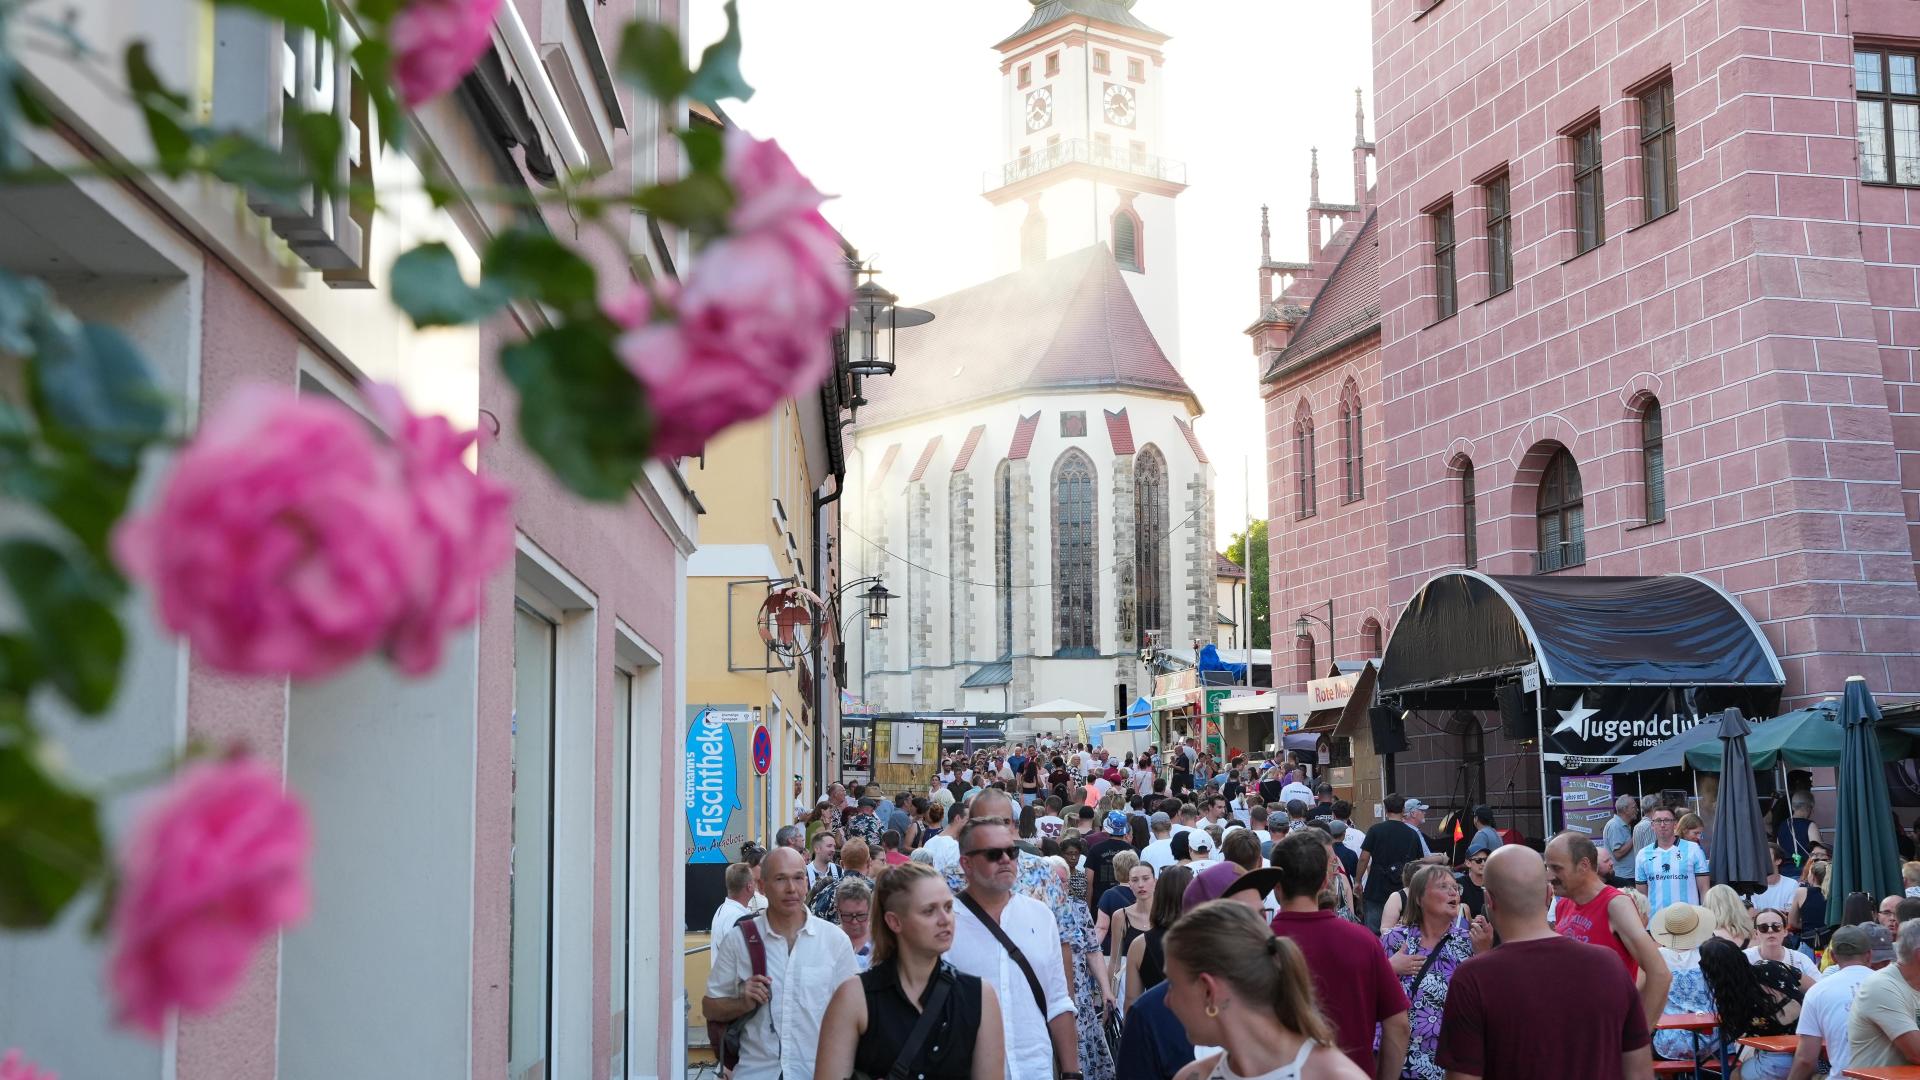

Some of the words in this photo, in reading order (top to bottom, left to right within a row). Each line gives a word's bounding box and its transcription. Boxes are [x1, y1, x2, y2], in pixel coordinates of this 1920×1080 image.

[1522, 664, 1538, 677] Notruf
[1527, 677, 1536, 688] 112
[1315, 687, 1335, 703] Rote
[1655, 873, 1689, 881] Bayerische
